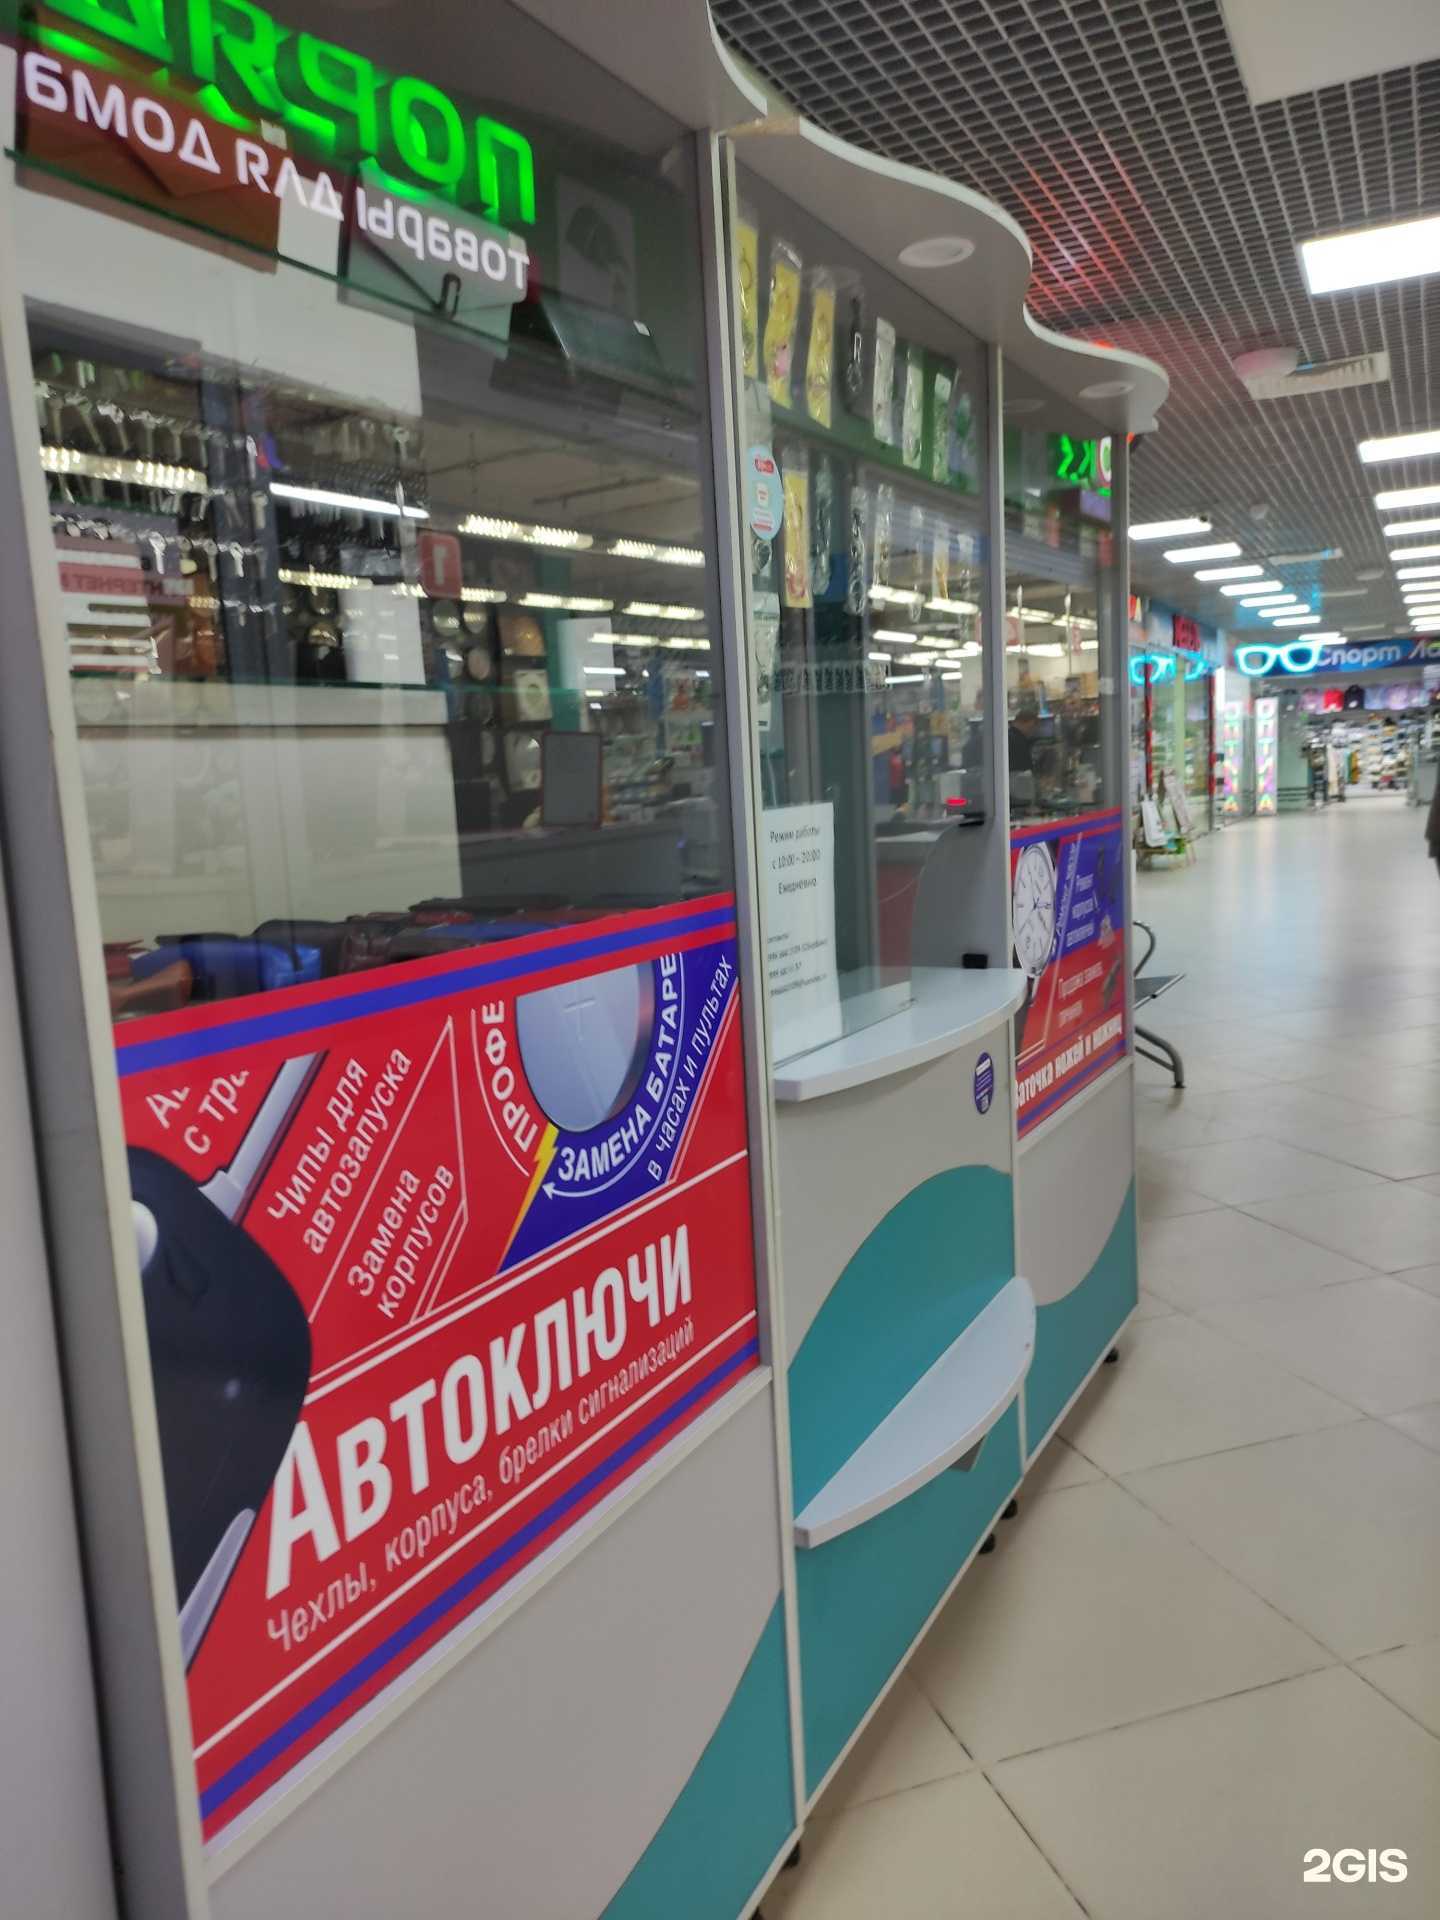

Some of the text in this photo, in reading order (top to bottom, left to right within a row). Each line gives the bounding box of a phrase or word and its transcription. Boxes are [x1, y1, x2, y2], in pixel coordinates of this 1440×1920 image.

[655, 1077, 691, 1153] часах
[682, 1055, 699, 1079] и
[691, 954, 733, 1056] пультах
[267, 1058, 369, 1221] Чипы для
[302, 1048, 412, 1254] автозапуска
[557, 1104, 653, 1182] ЗАМЕНА
[347, 1168, 421, 1297] Замена
[376, 1164, 455, 1319] корпусов
[266, 1317, 695, 1652] Чехлы, корпуса, брелки сигнализаций
